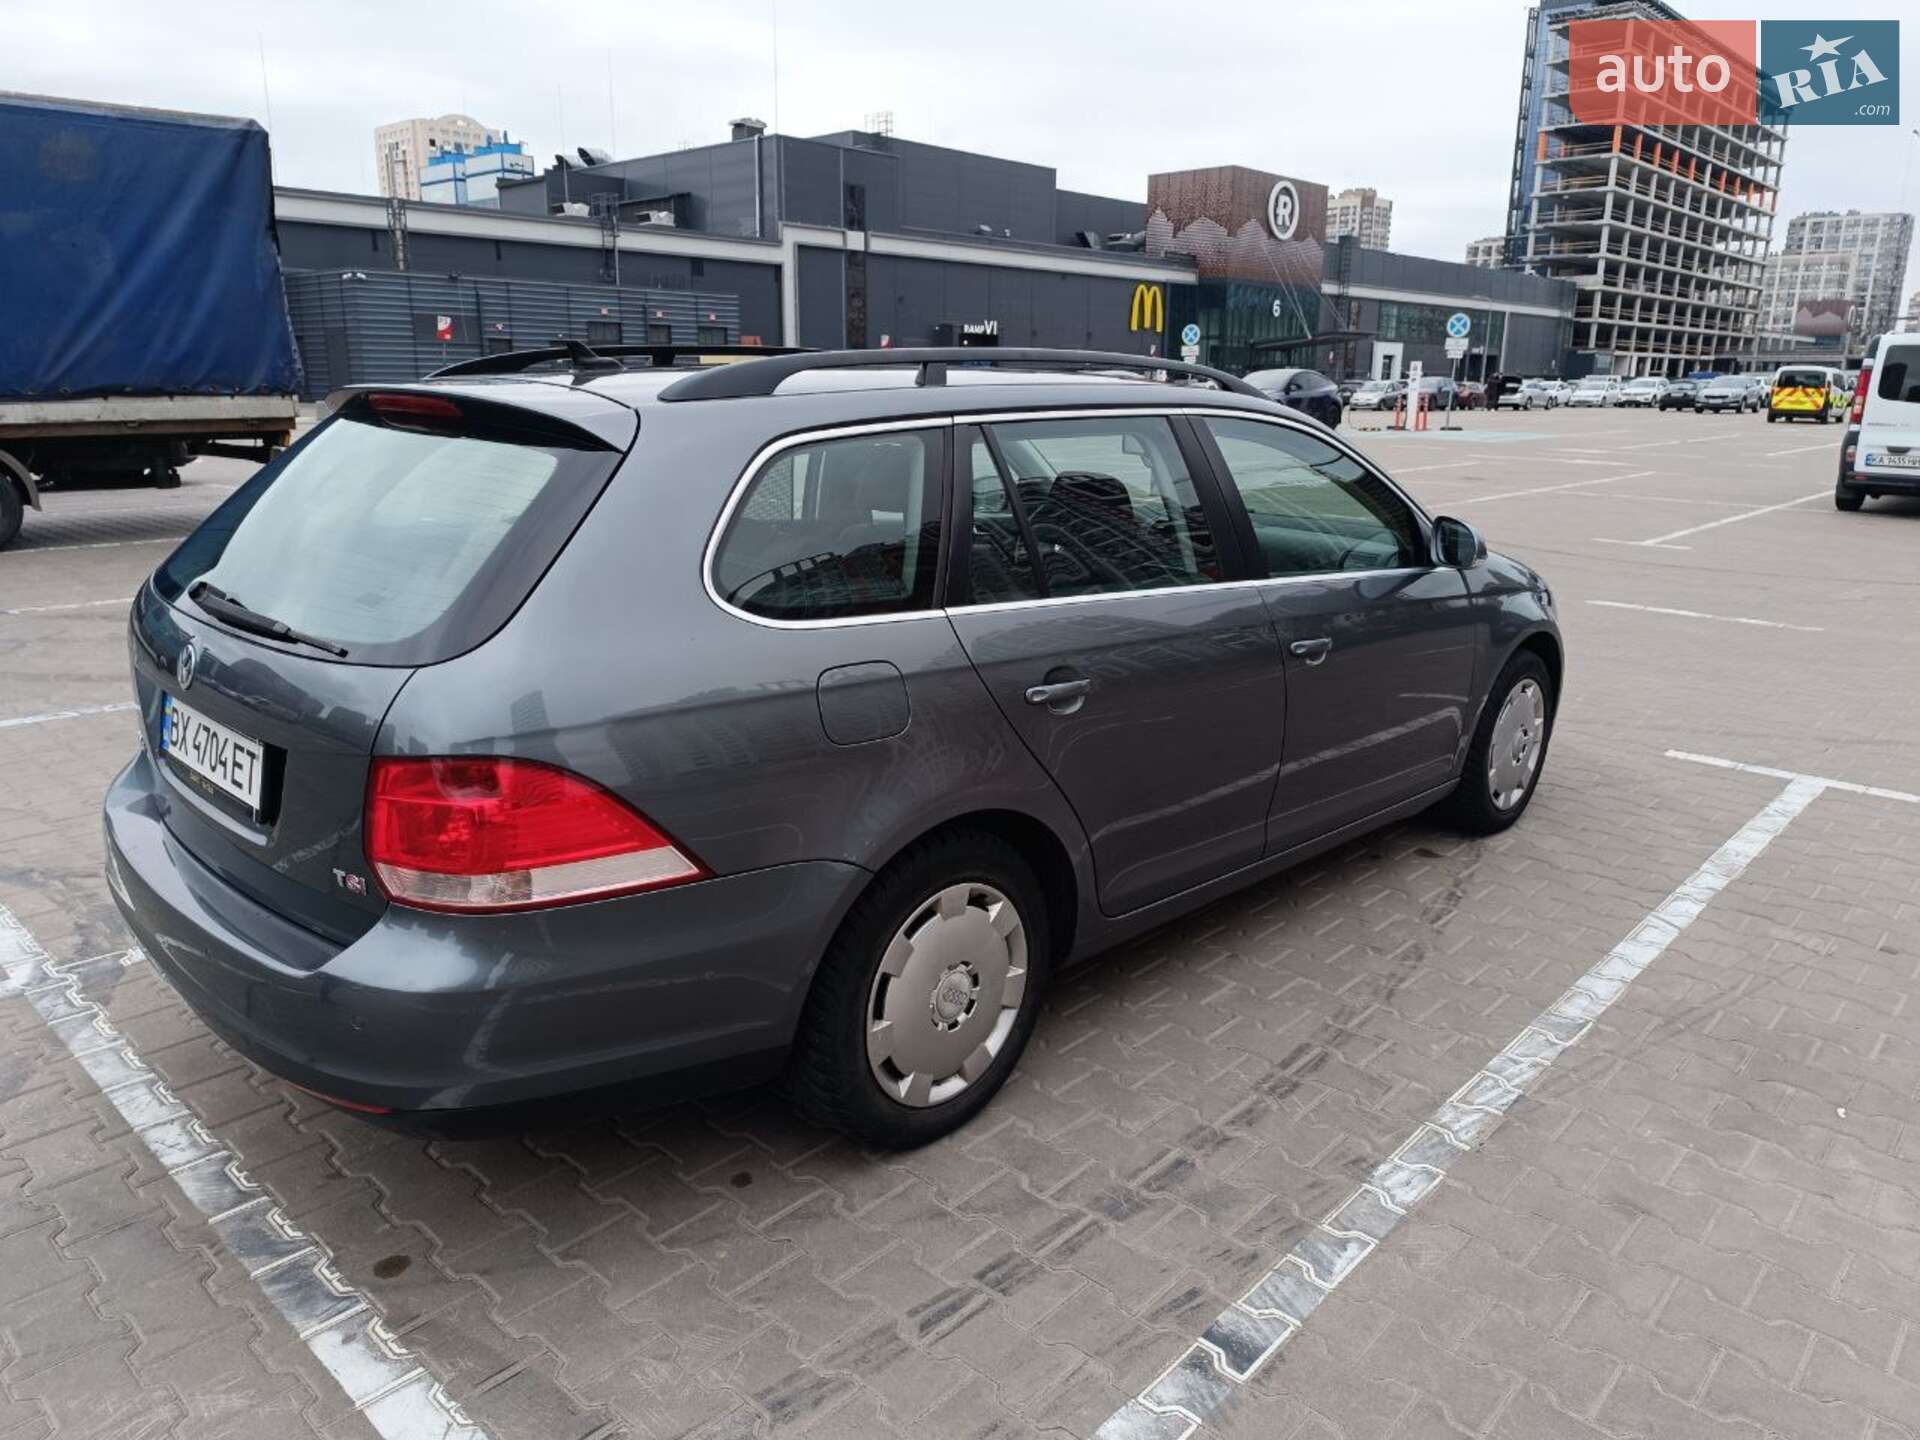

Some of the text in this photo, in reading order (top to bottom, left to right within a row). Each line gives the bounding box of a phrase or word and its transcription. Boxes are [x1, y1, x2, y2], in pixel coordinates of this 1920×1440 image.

[1272, 299, 1281, 318] 6
[170, 706, 191, 757] BX
[193, 722, 229, 781] 4704
[231, 742, 257, 795] ET
